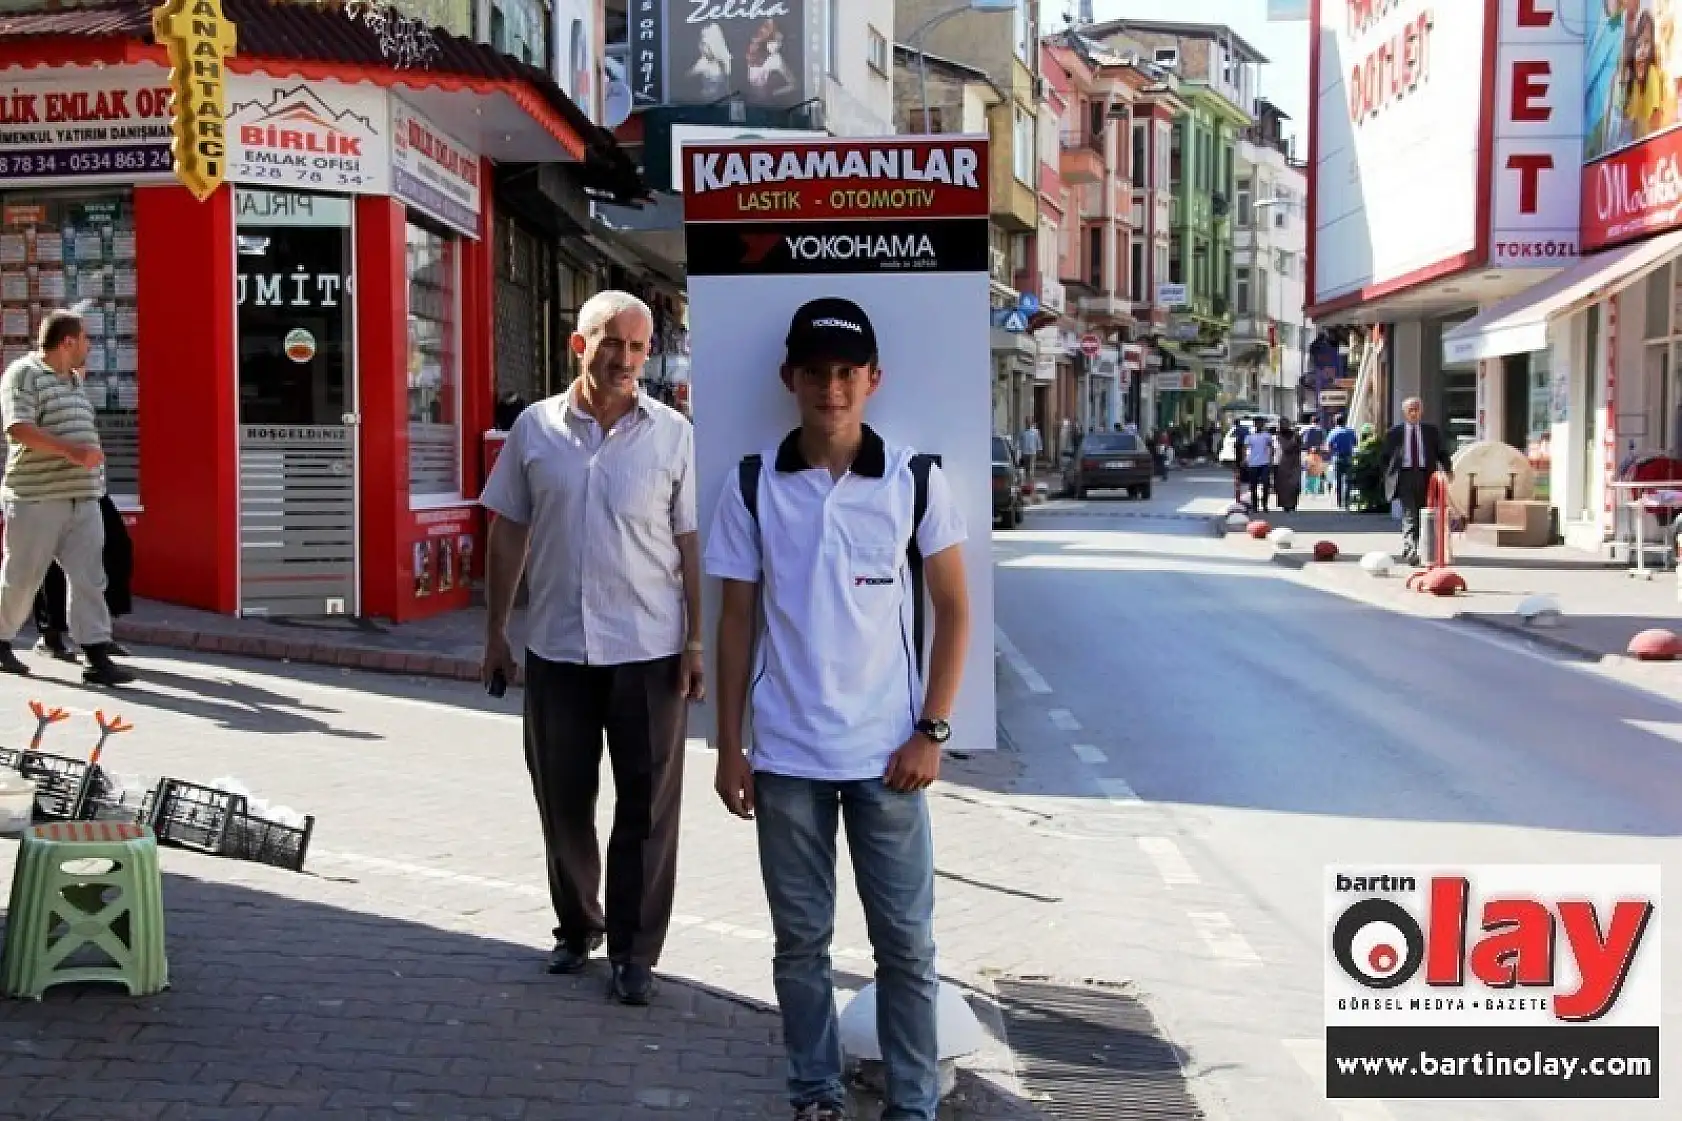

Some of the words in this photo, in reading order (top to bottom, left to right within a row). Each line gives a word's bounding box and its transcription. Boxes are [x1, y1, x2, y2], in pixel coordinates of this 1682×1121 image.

[45, 90, 131, 122] EMLAK
[136, 88, 175, 118] OF
[192, 1, 223, 177] ANAHTARCI
[240, 123, 362, 157] BİRLİK
[12, 156, 33, 173] 78
[37, 155, 56, 172] 34
[70, 152, 111, 170] 0534
[114, 151, 144, 168] 863
[150, 149, 169, 166] 24
[245, 151, 307, 167] EMLAK
[693, 148, 979, 193] KARAMANLAR
[785, 233, 936, 259] YOKOHAMA
